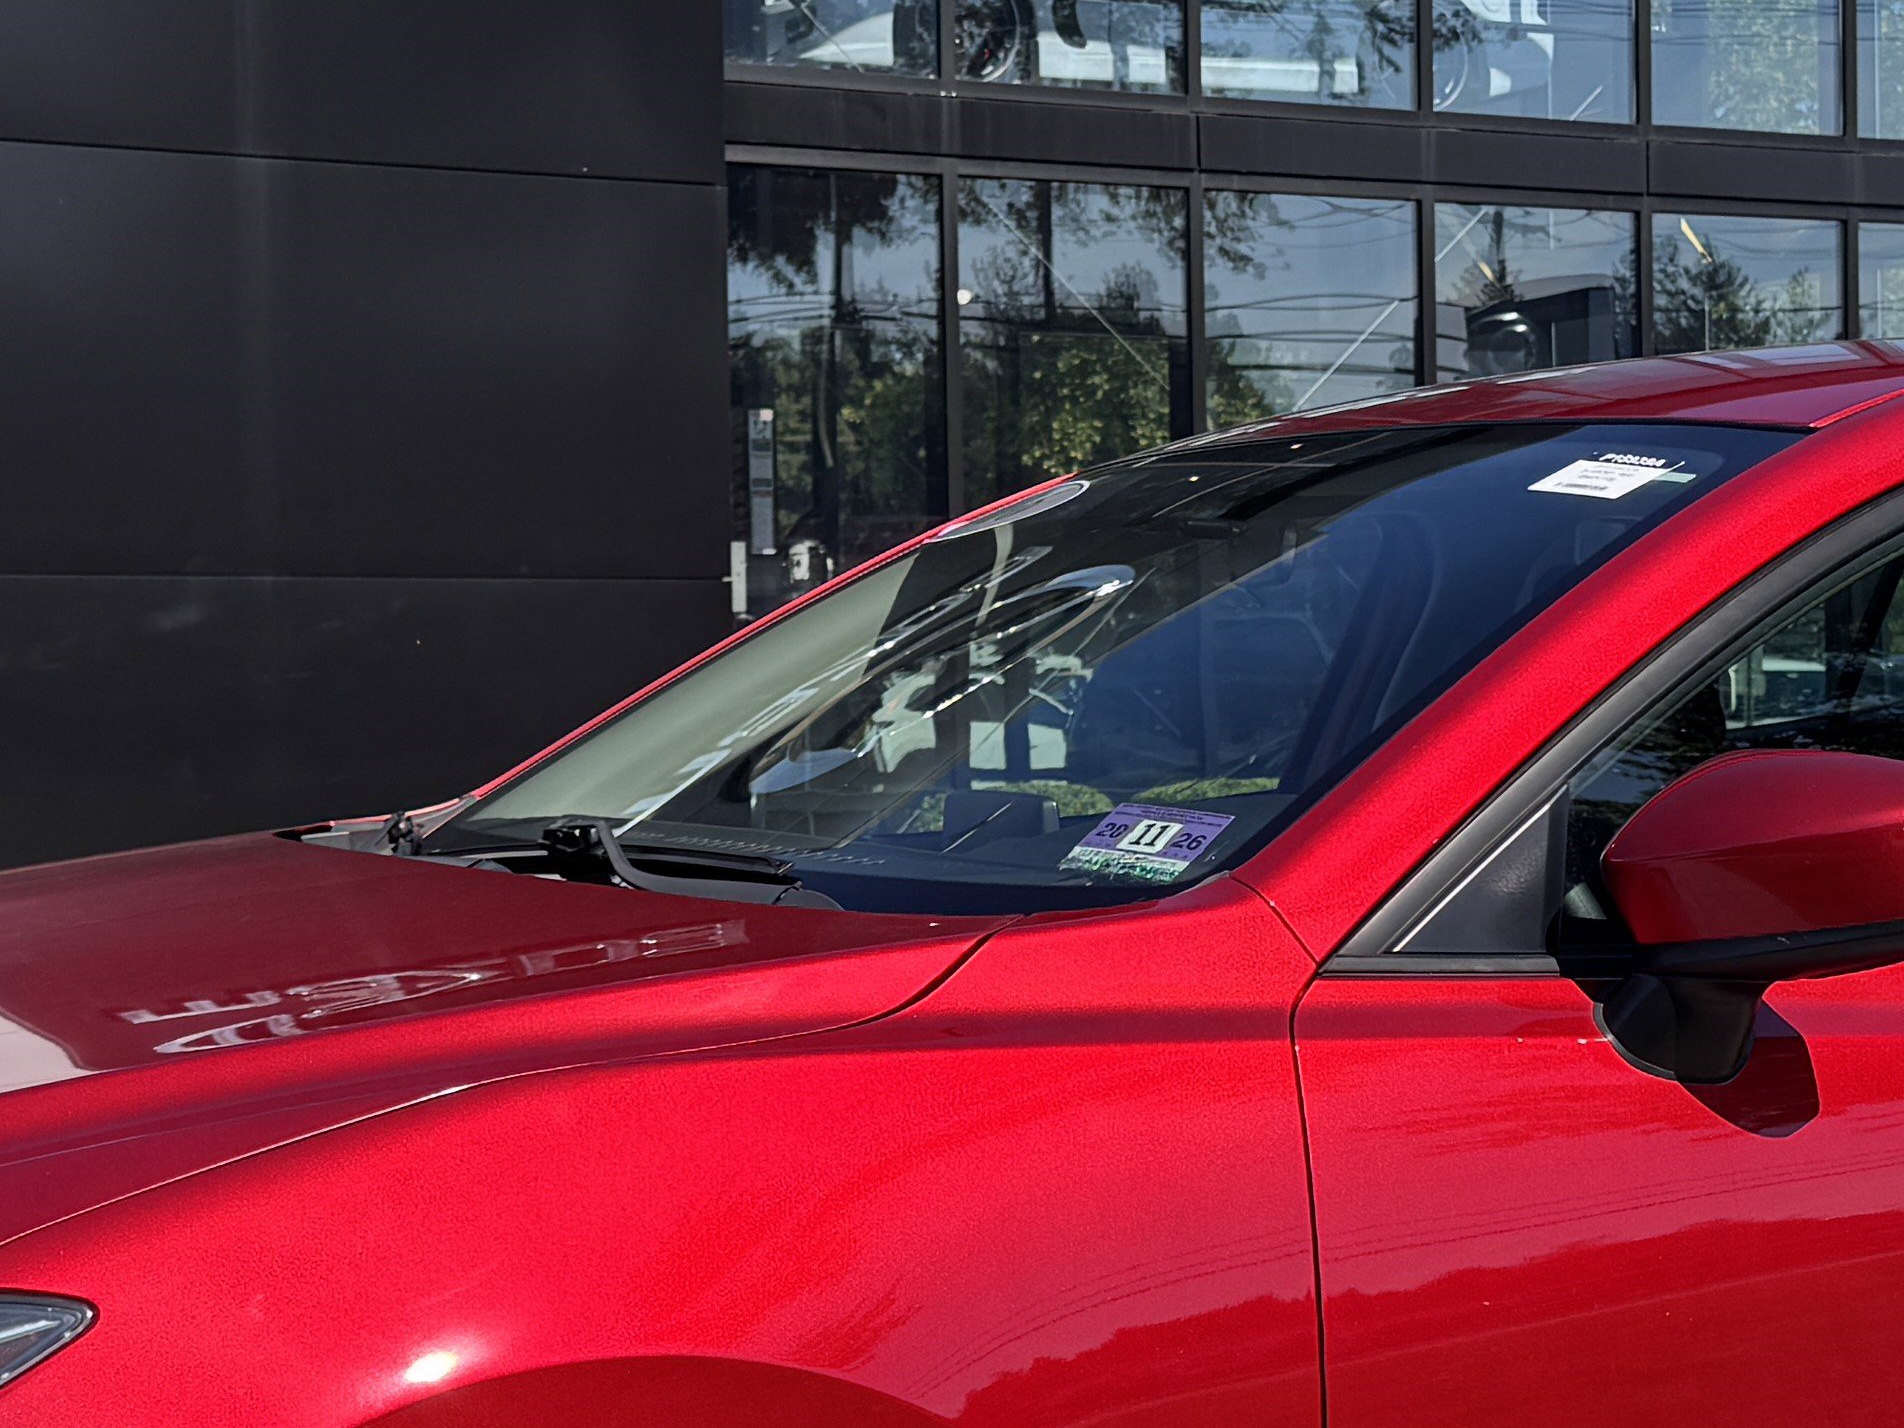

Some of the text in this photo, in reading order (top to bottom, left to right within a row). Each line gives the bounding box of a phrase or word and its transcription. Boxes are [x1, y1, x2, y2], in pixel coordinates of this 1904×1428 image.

[1095, 821, 1208, 851] 20 11 26
